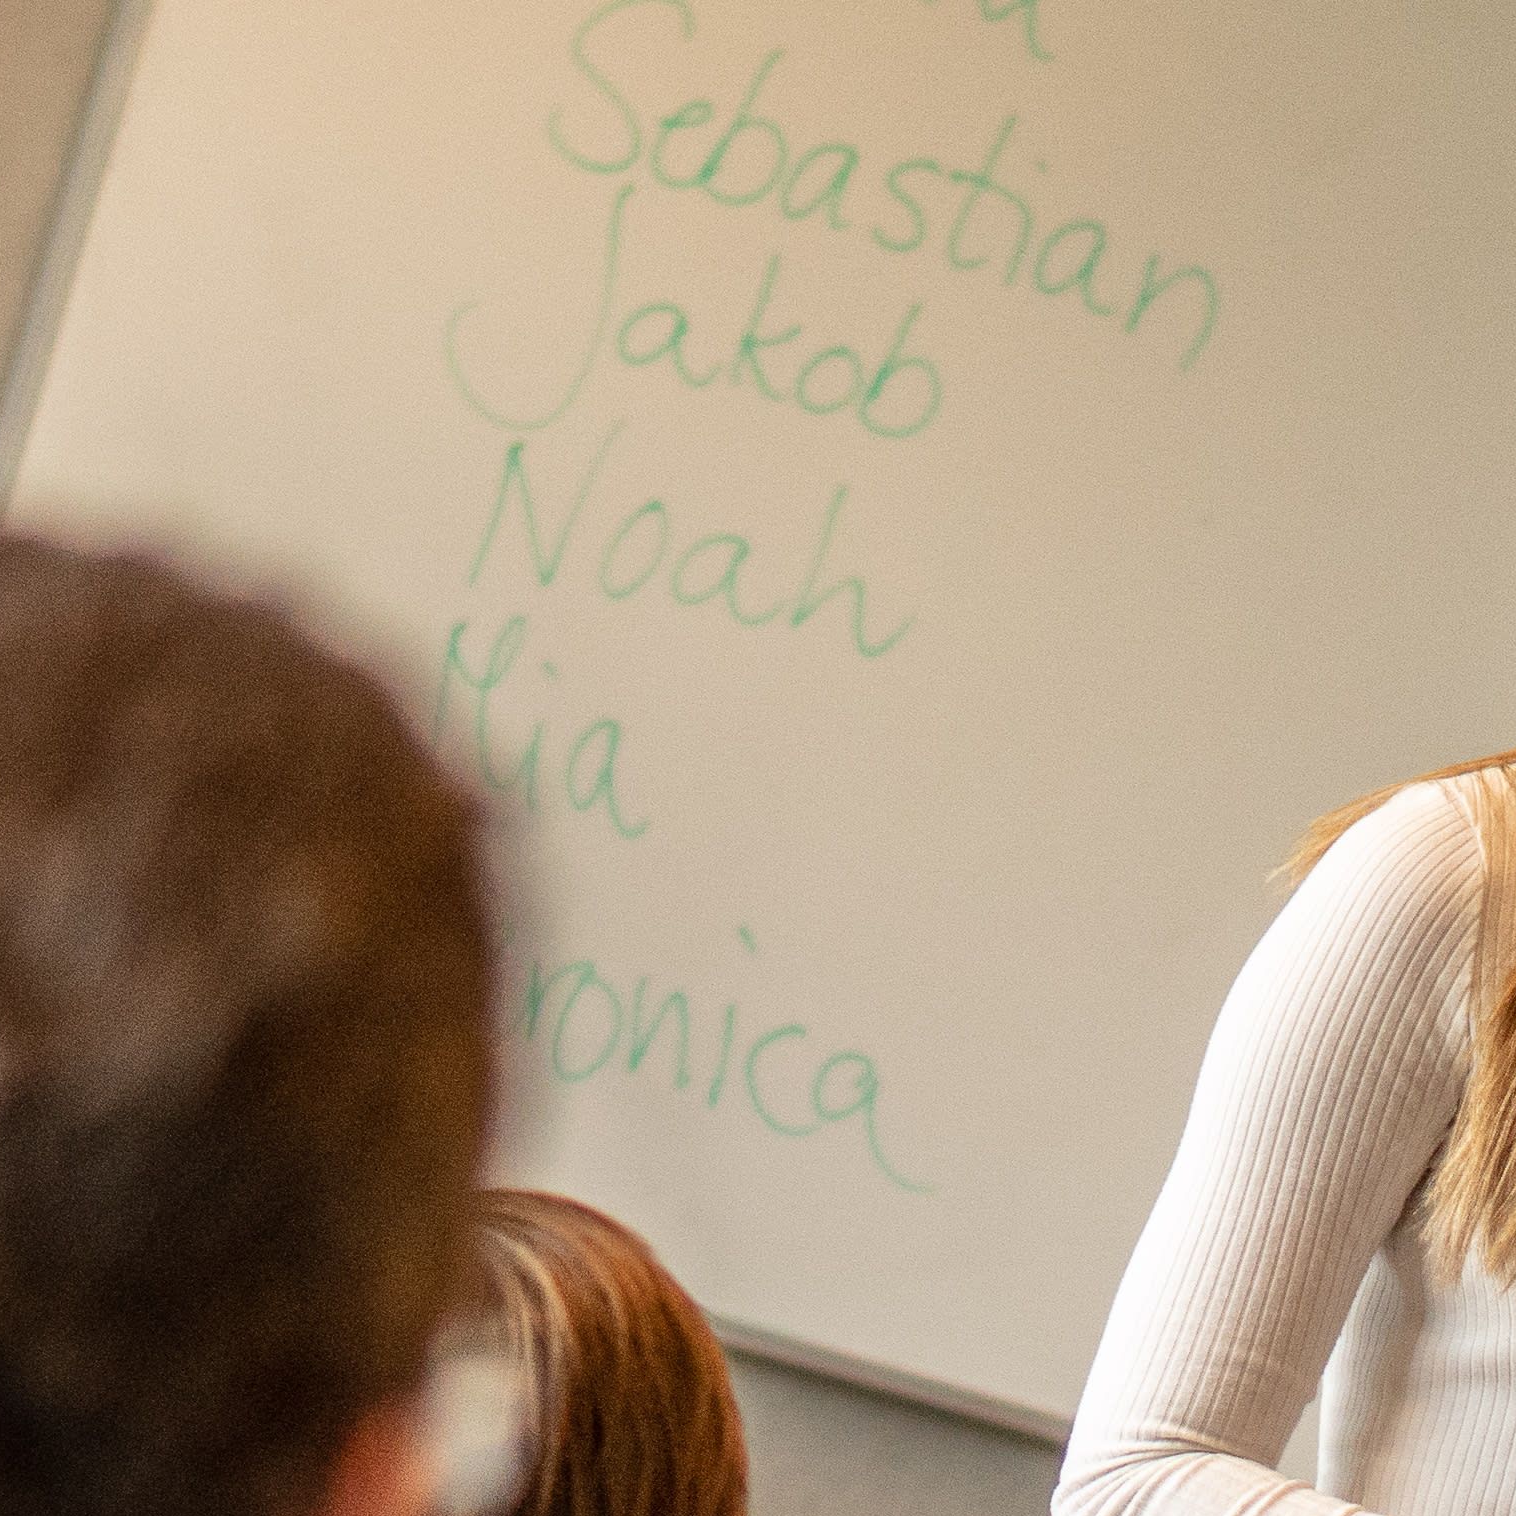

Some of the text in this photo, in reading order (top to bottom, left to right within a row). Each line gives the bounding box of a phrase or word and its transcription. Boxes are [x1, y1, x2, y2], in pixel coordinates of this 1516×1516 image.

[443, 182, 942, 438] Jakob
[548, 0, 1219, 374] Sebastian
[467, 415, 917, 659] Noah
[502, 918, 938, 1195] ronica
